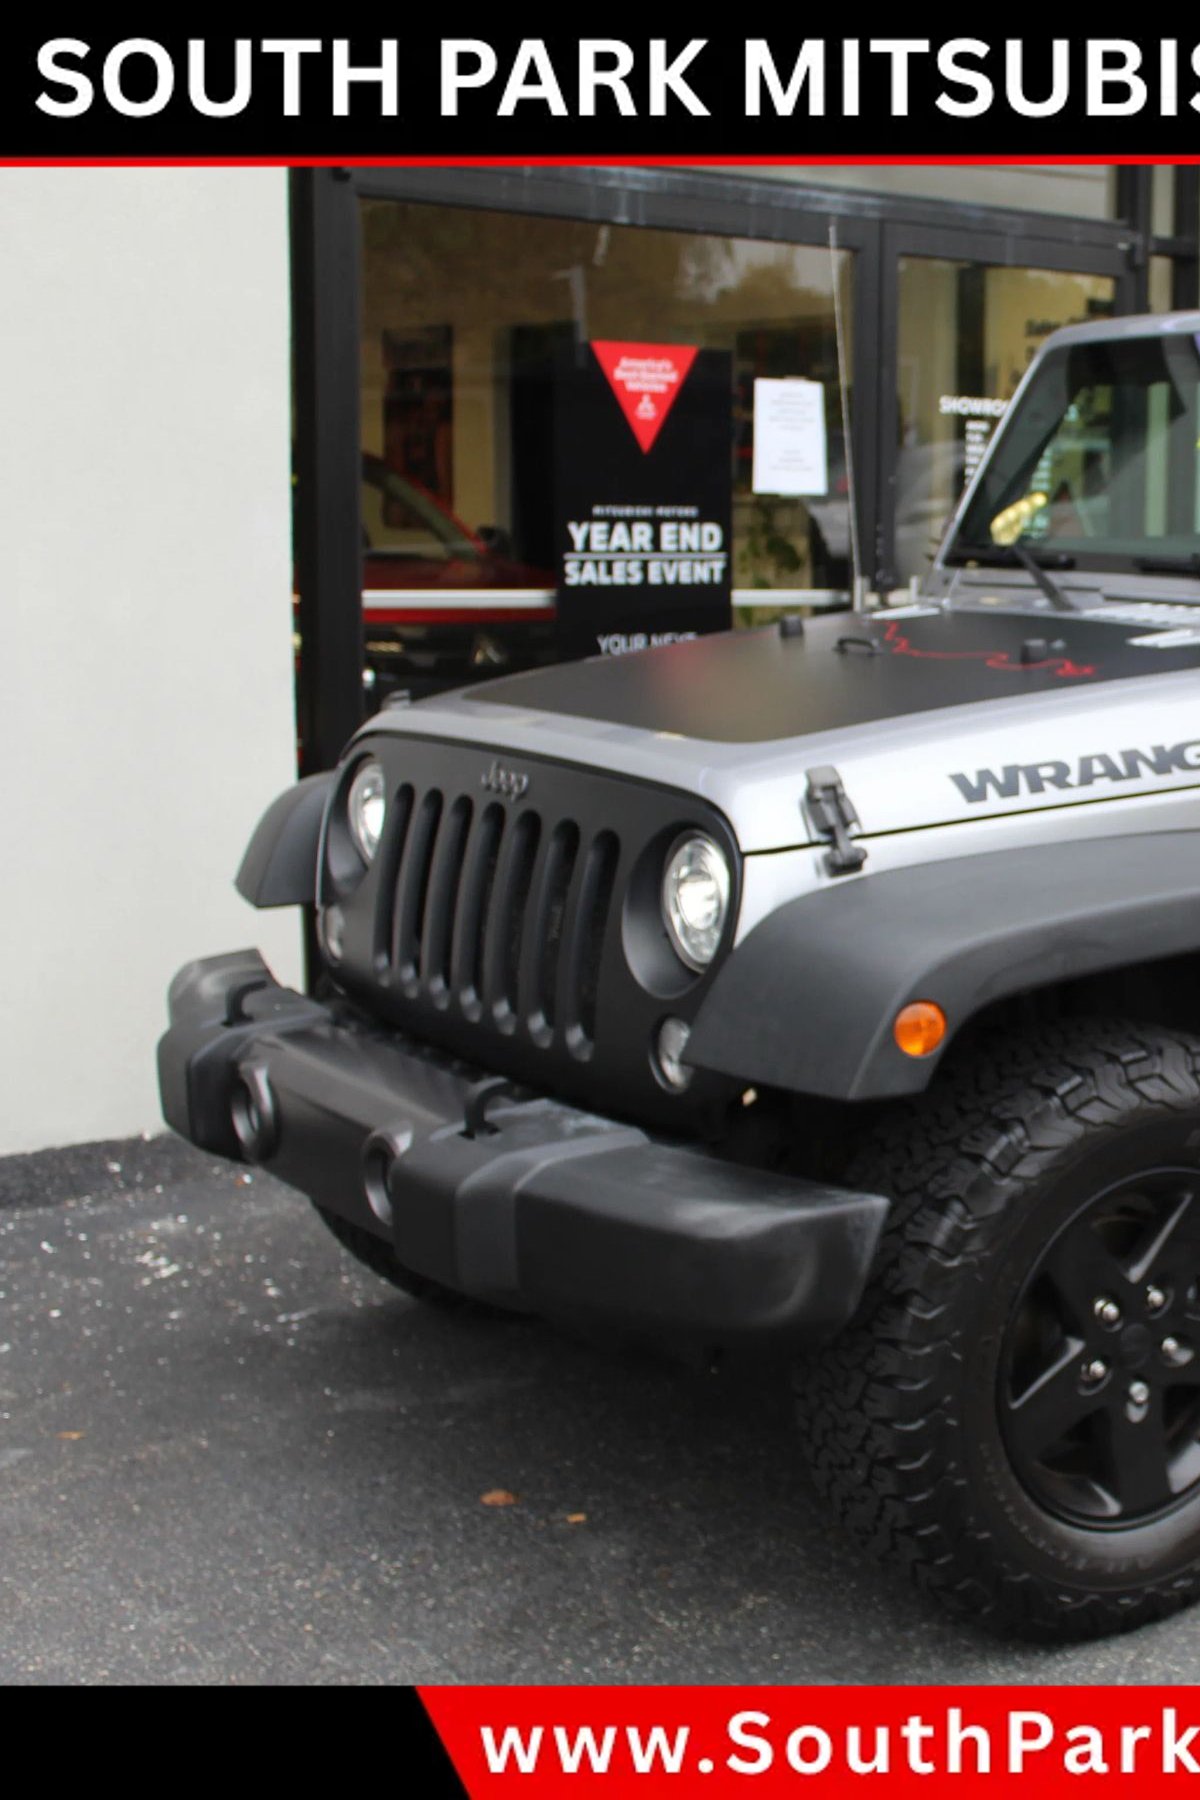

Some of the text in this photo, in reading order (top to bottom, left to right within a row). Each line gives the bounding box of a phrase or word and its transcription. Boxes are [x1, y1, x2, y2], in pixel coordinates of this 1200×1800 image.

[568, 521, 722, 551] YEAR END
[564, 560, 726, 585] SALES EVENT
[597, 633, 647, 655] YOUR
